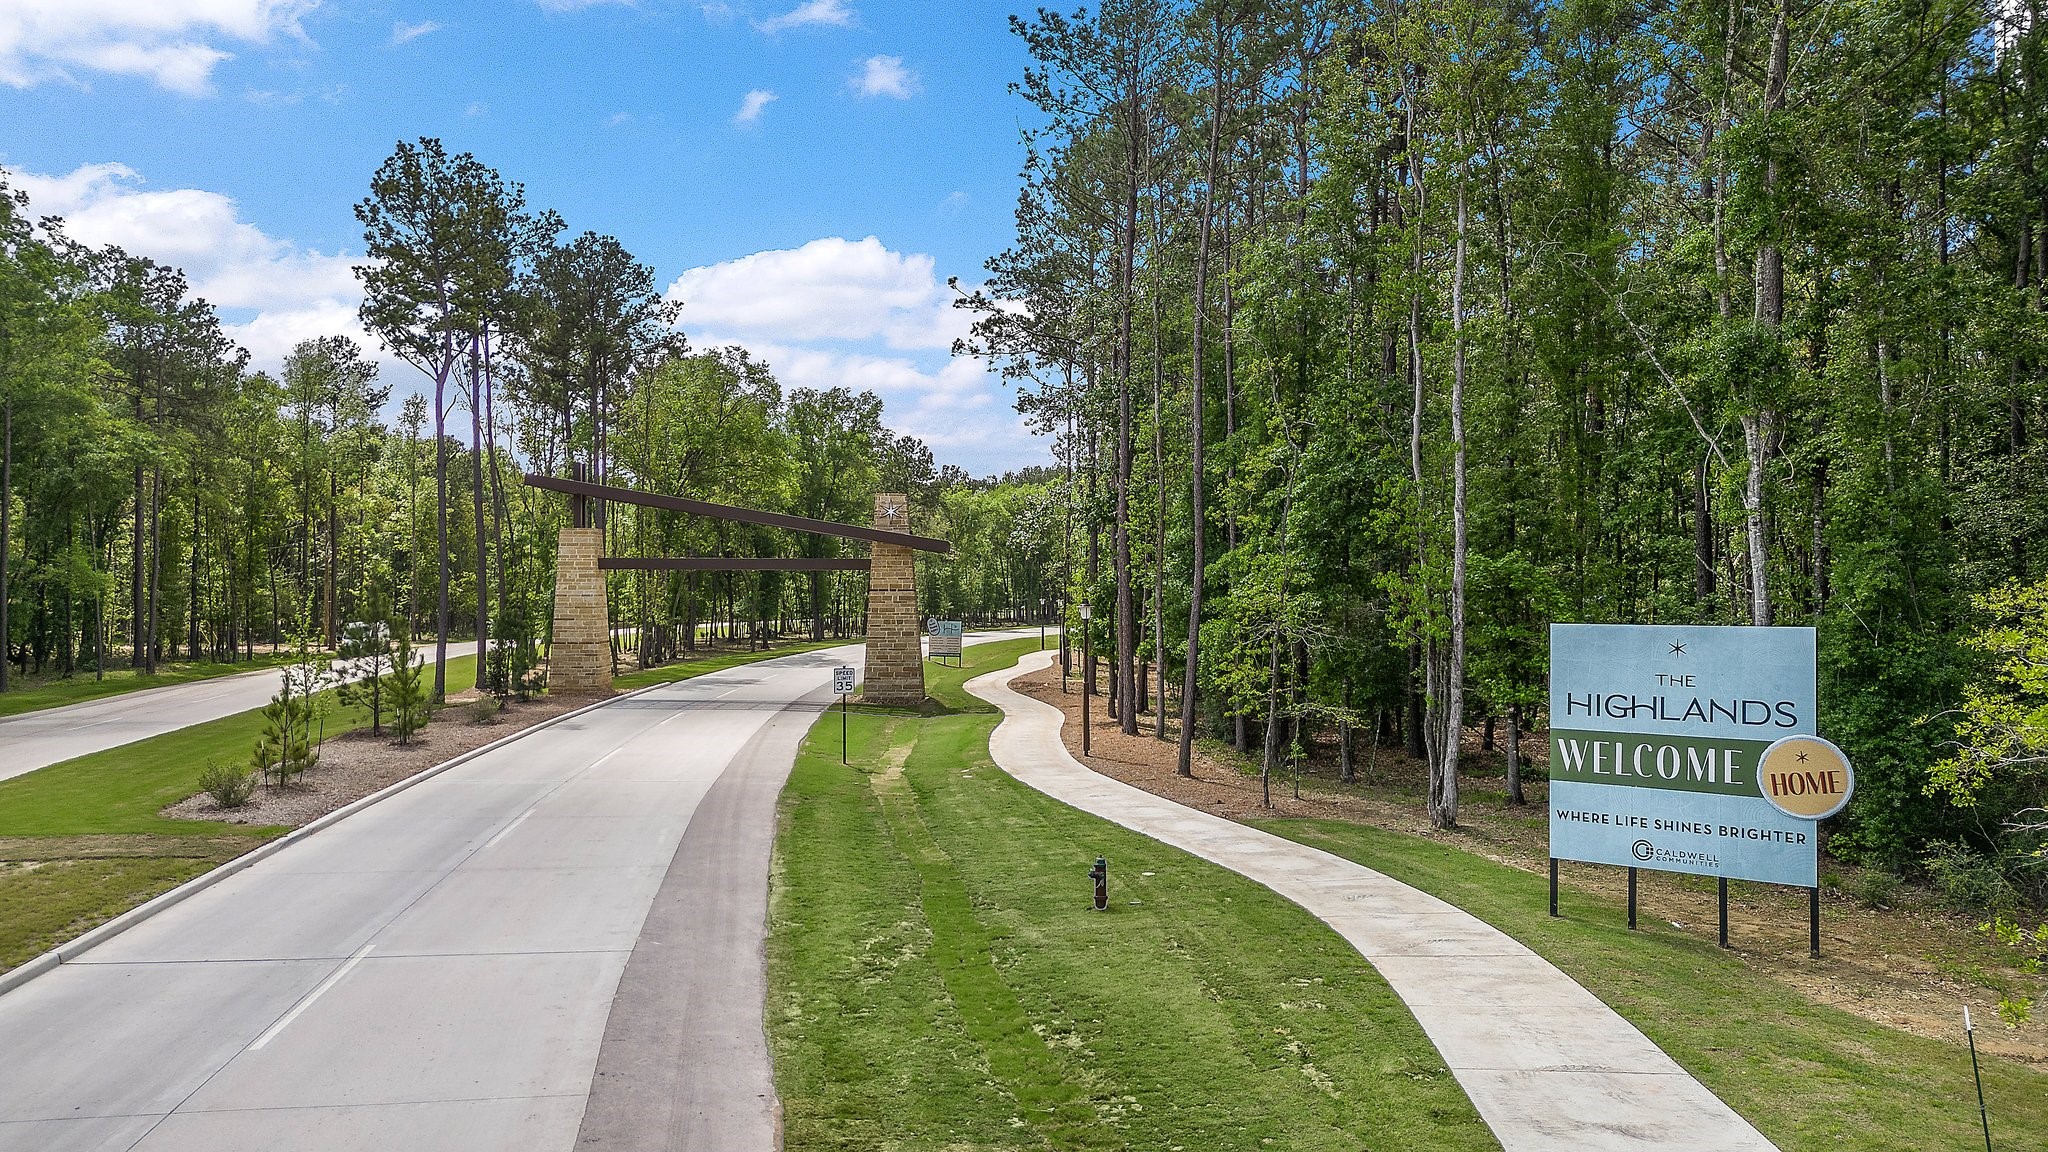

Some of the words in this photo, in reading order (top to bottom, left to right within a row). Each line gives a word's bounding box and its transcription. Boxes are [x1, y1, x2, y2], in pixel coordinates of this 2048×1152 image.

[836, 681, 853, 691] 35
[1655, 674, 1696, 687] THE
[1567, 692, 1798, 728] HIGHLANDS
[1557, 738, 1744, 785] WELCOME
[1771, 770, 1843, 797] HOME
[1556, 810, 1609, 825] WHERE
[1615, 815, 1648, 829] LIFE
[1654, 819, 1712, 835] SHINES
[1718, 825, 1806, 845] BRIGHTER
[1656, 848, 1718, 862] CALDWELL
[1656, 856, 1719, 868] COMMUNITIES
